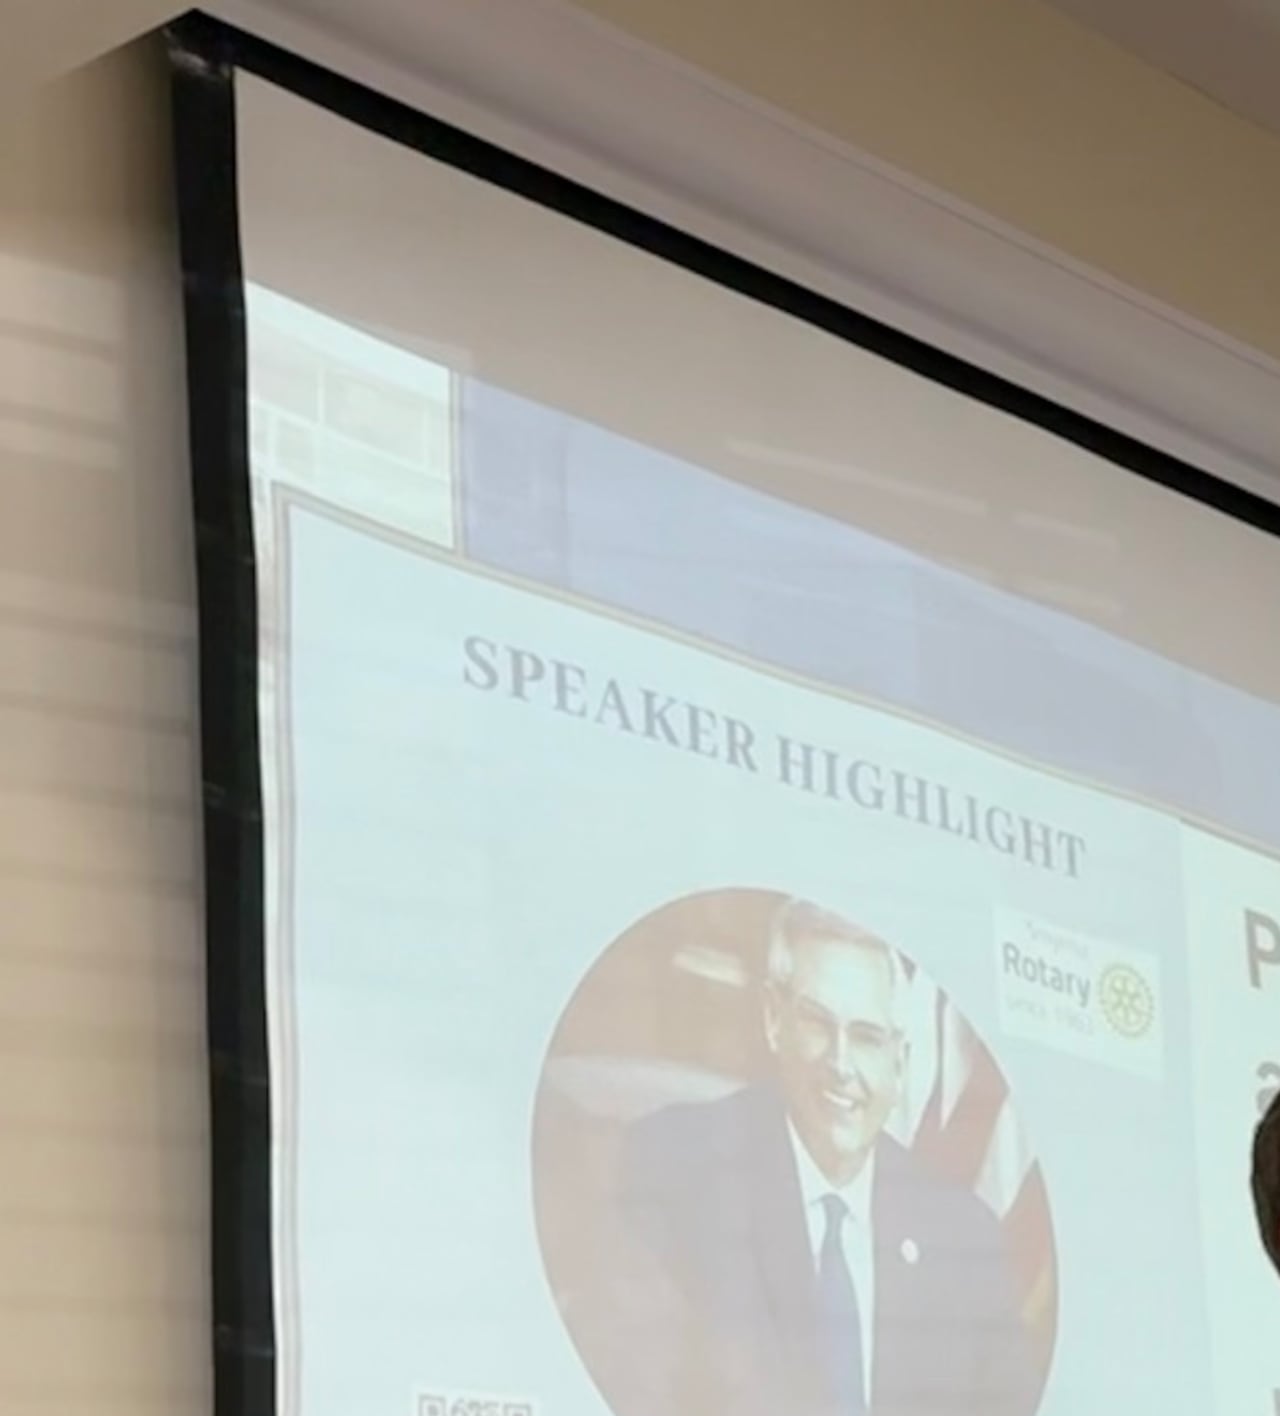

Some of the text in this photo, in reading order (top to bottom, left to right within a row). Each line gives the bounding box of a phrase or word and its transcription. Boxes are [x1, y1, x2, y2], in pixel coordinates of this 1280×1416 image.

[462, 635, 1087, 879] SPEAKER HIGHLIGHT
[1002, 941, 1091, 1008] Rotary
